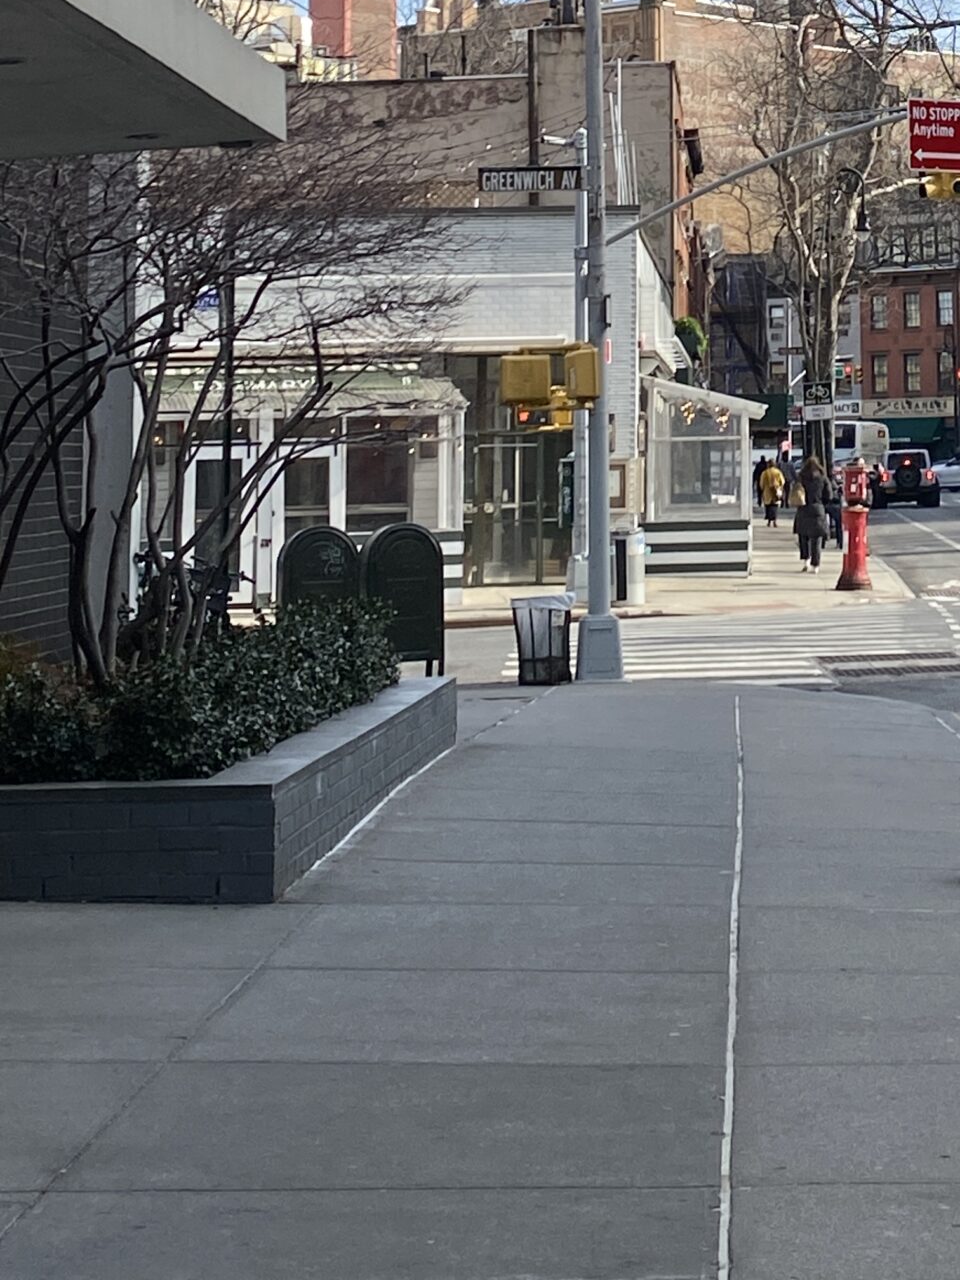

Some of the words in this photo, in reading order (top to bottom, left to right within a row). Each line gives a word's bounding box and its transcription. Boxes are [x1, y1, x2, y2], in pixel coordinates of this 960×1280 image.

[912, 106, 927, 119] NO
[913, 123, 955, 139] Anytime
[482, 171, 554, 191] GREENWICH
[561, 170, 578, 189] AV
